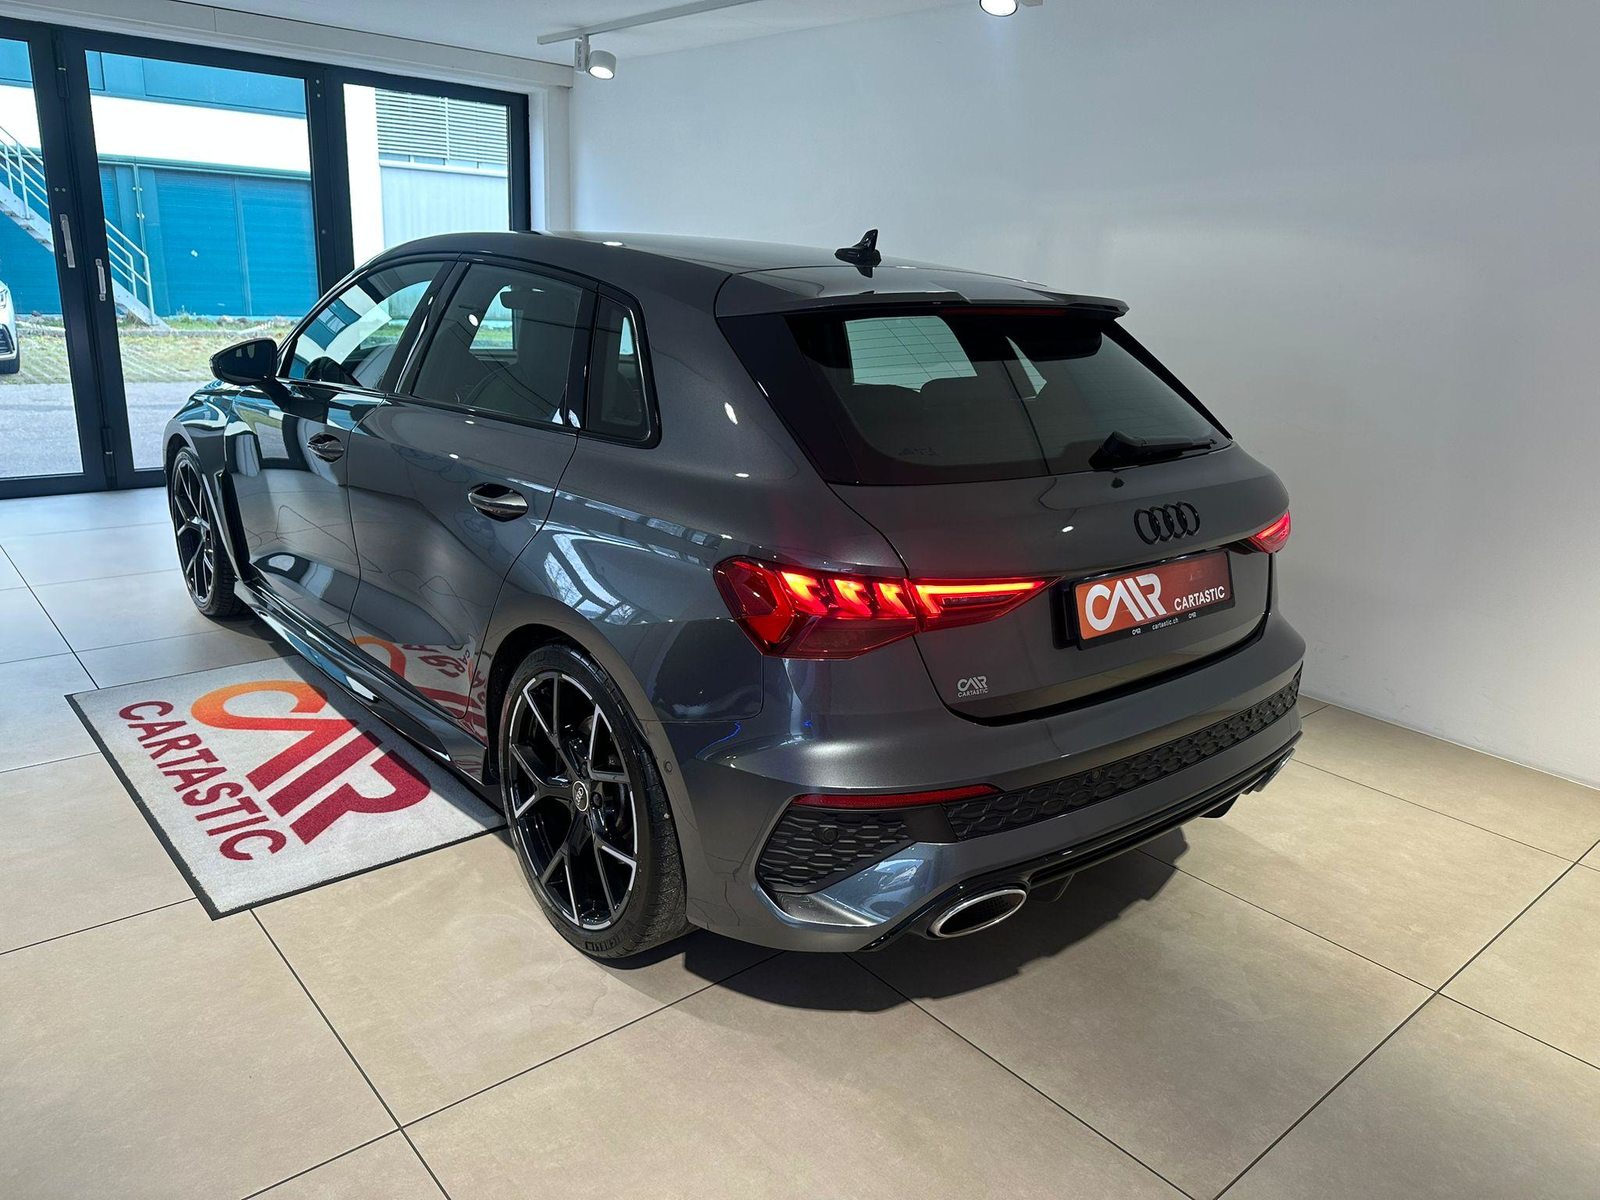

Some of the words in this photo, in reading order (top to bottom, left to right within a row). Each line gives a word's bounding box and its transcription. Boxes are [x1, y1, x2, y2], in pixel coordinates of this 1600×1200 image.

[1174, 586, 1225, 611] CARTASTIC
[1152, 618, 1179, 630] cartastic.ch
[958, 688, 988, 698] CARTASTIC
[119, 700, 287, 861] CARTASTIC
